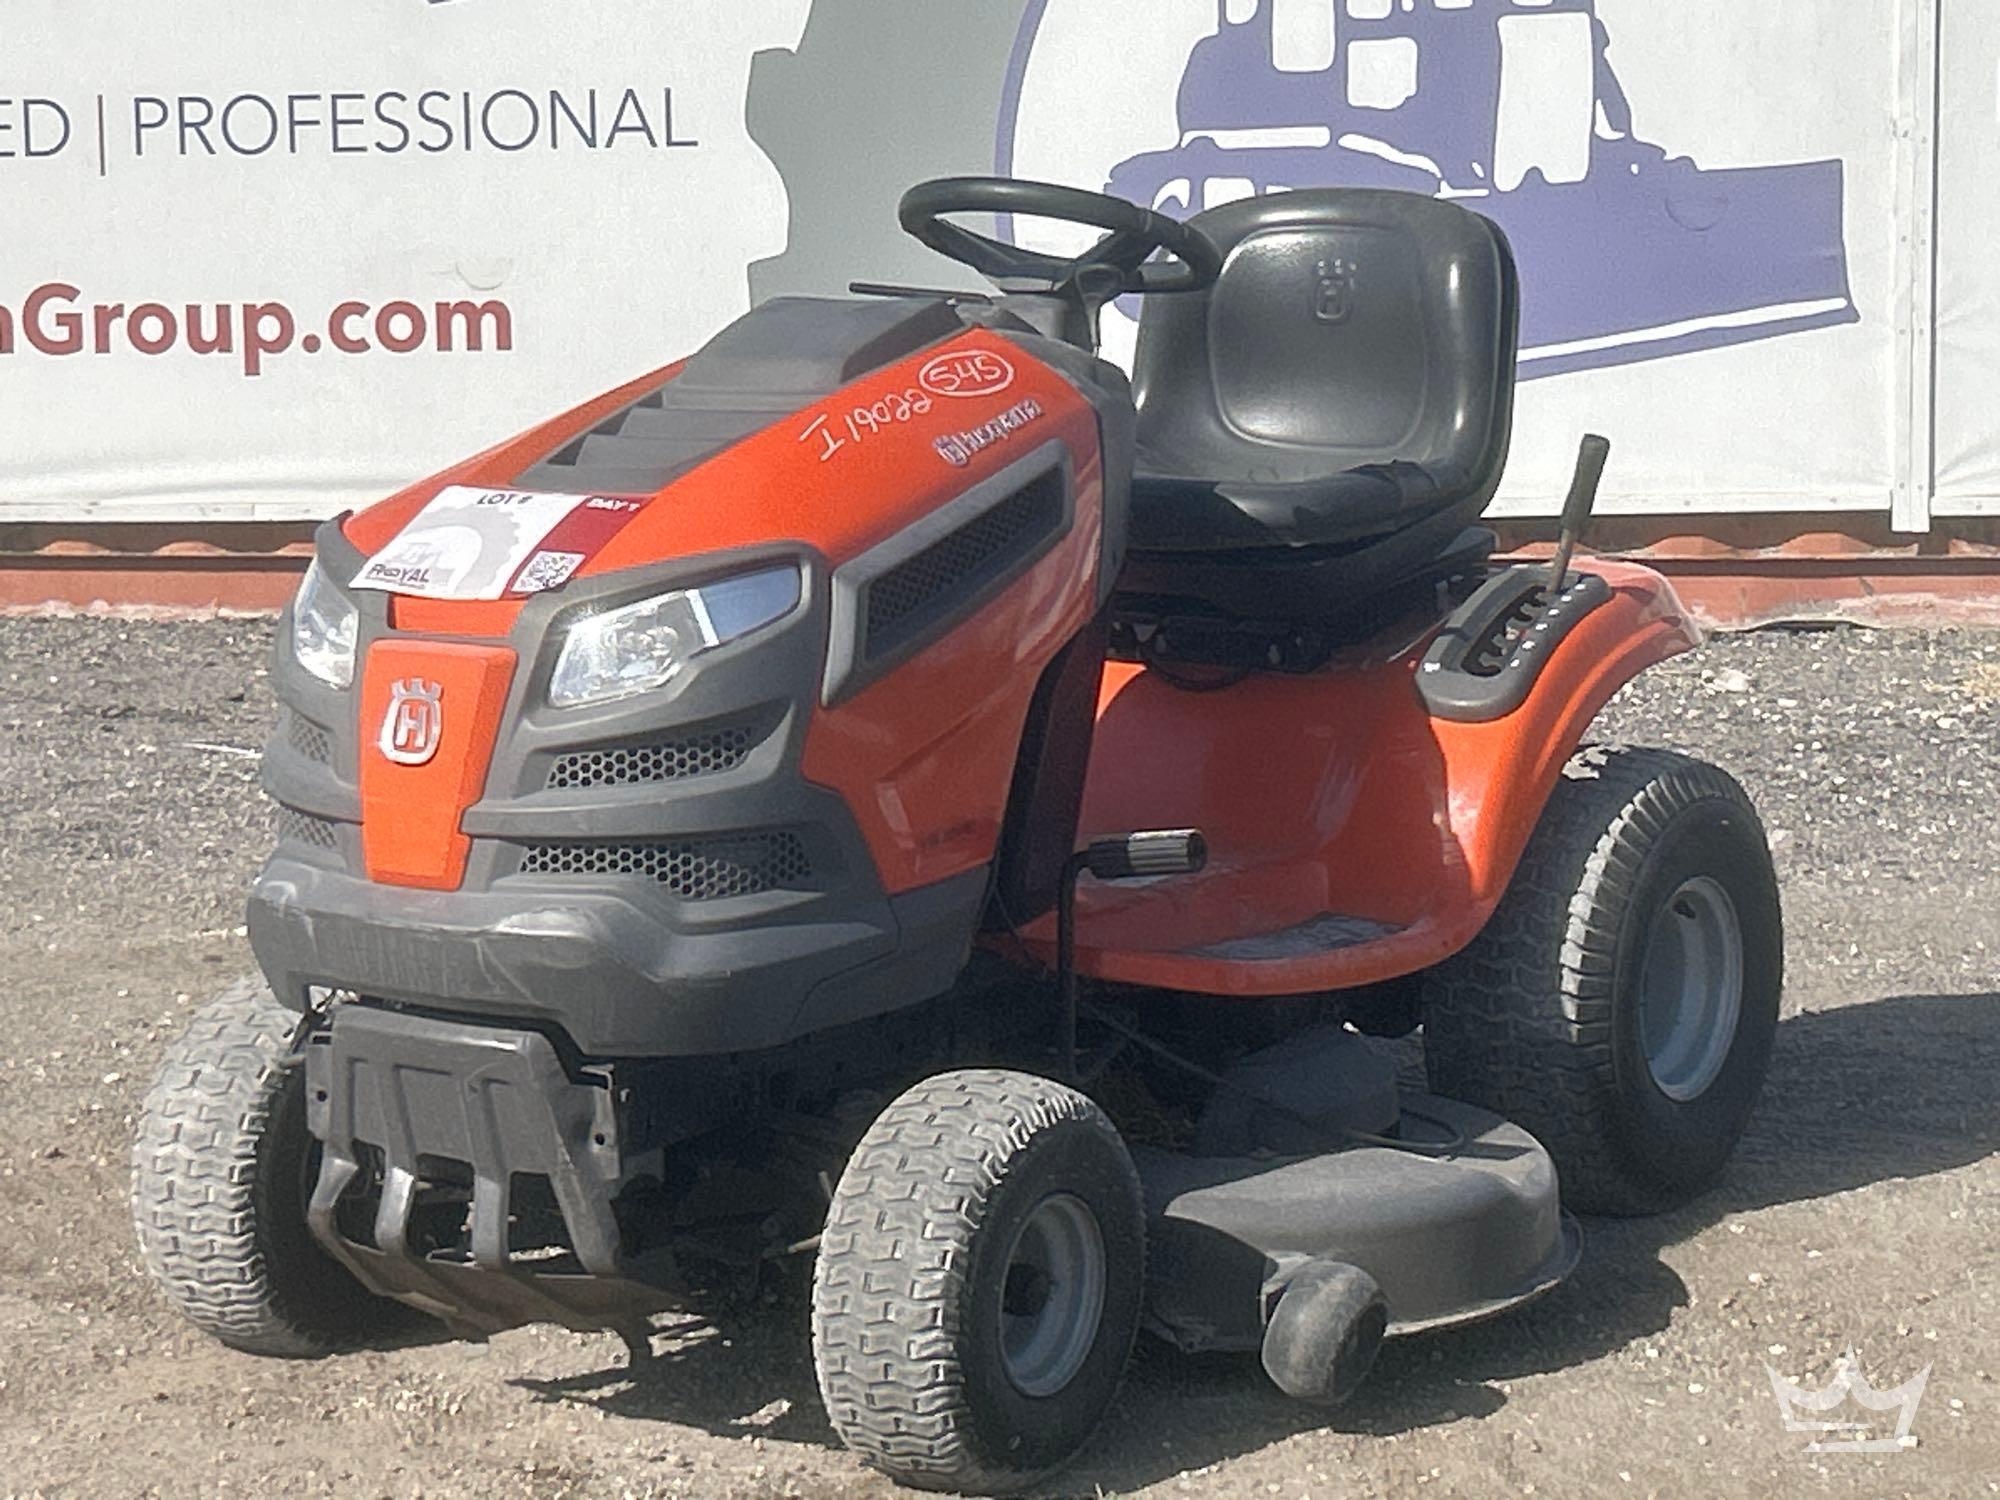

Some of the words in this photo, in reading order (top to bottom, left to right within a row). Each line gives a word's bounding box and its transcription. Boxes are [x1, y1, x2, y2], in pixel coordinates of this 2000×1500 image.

[133, 87, 698, 156] PROFESSIONAL
[477, 493, 517, 505] LOT
[367, 563, 430, 583] ROYAL
